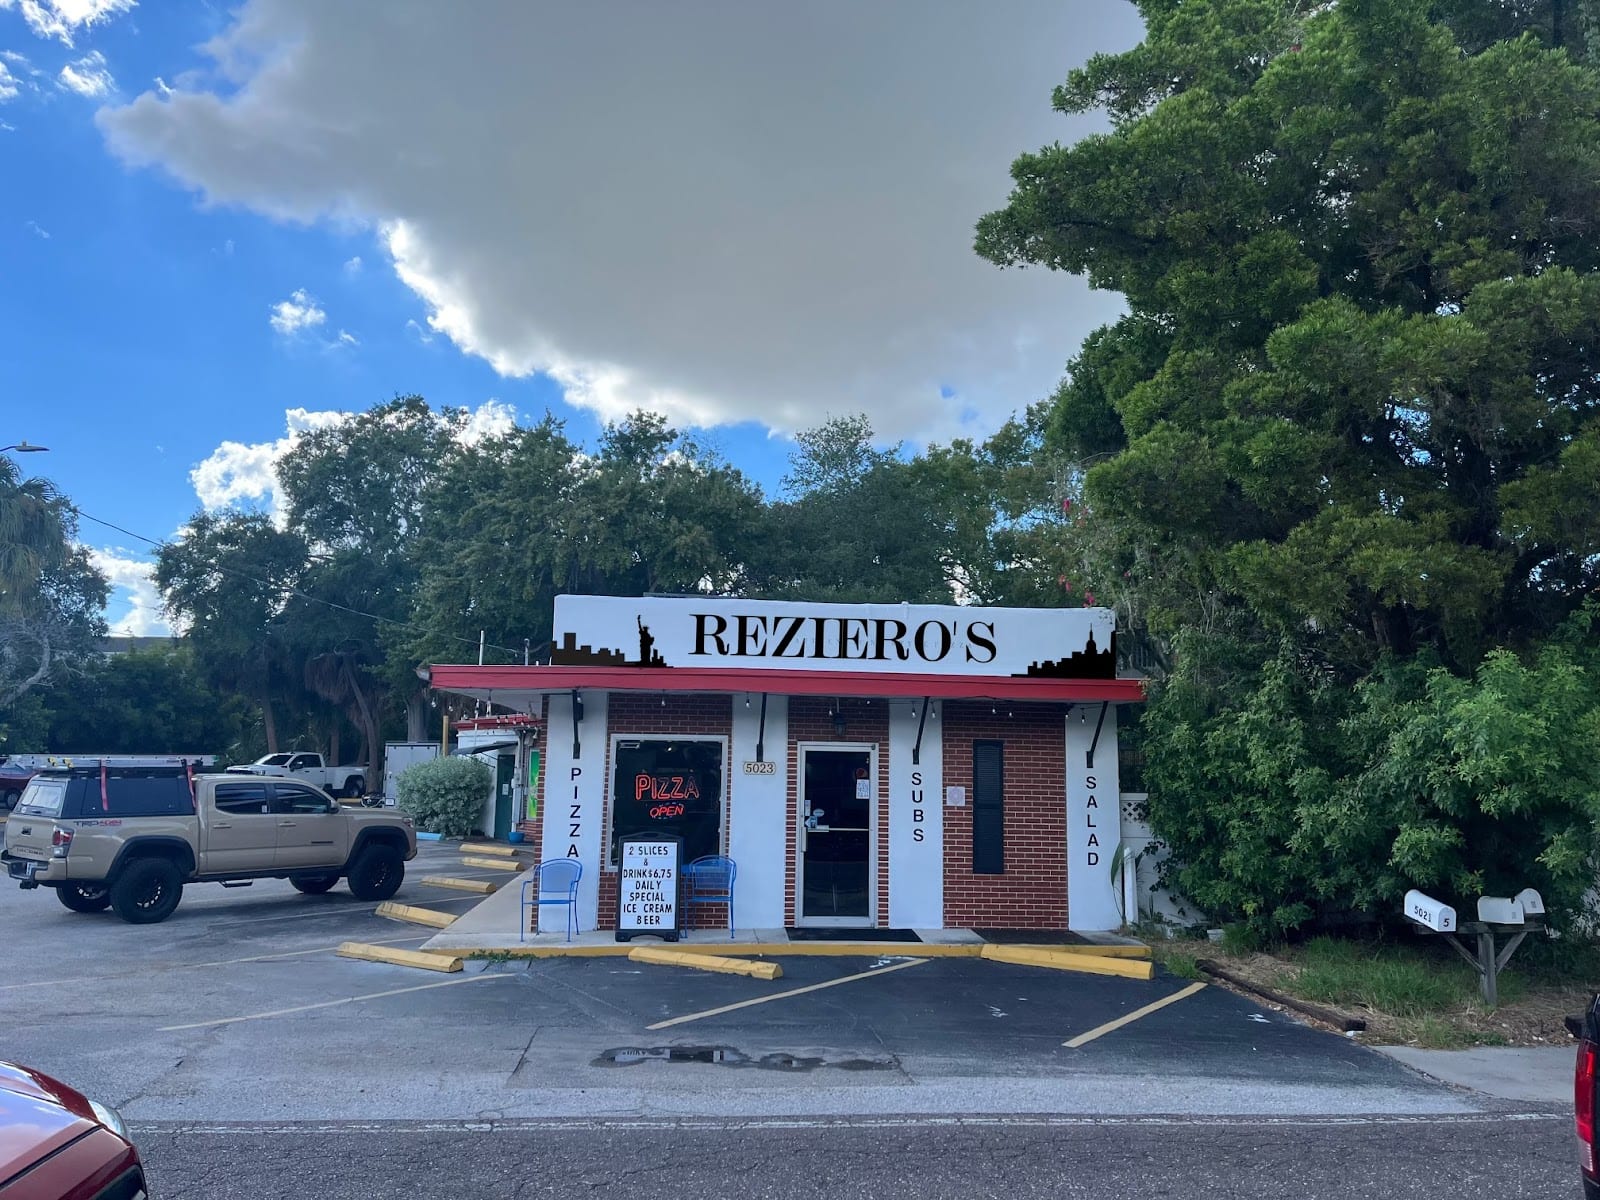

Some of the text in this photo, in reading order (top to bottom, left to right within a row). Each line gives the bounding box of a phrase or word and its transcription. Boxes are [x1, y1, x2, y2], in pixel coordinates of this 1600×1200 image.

[688, 614, 997, 663] REZIERO'S
[745, 763, 774, 774] 5023
[567, 767, 582, 858] PIZZA
[649, 805, 684, 817] OPEN
[911, 772, 924, 842] SUBS
[1086, 776, 1099, 866] SALAD
[628, 846, 669, 856] 2 SLICES
[635, 881, 662, 890] DAILY
[629, 892, 665, 902] SPECIAL
[623, 904, 673, 913] ICE CREAM
[1414, 905, 1432, 923] 5021
[636, 915, 661, 925] BEER
[1442, 917, 1451, 928] 5
